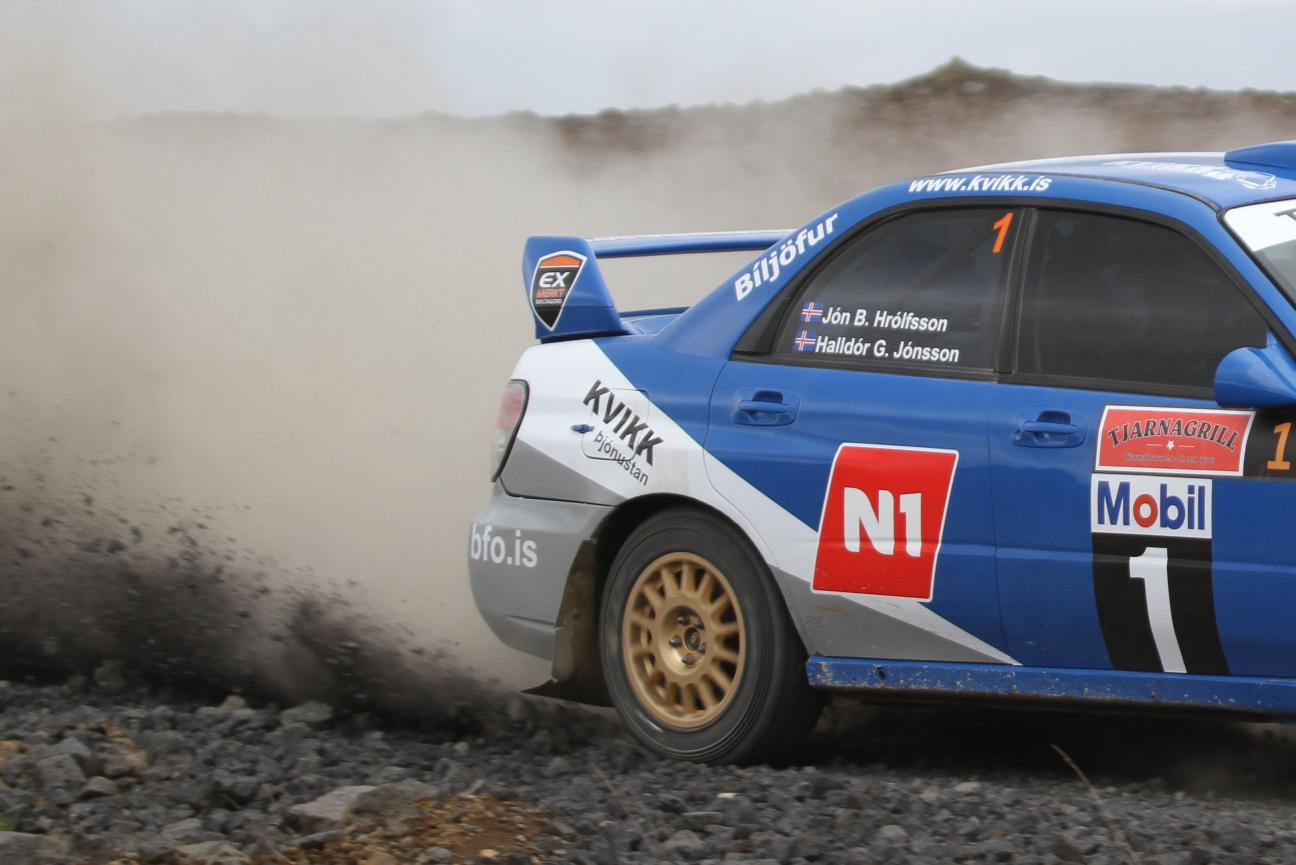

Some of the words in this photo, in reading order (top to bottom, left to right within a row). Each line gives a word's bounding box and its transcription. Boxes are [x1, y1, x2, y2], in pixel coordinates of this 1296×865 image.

[908, 175, 1053, 193] www.kvikk.is
[991, 211, 1015, 254] 1
[538, 271, 571, 288] EX
[821, 306, 851, 325] Jón
[853, 308, 869, 326] B.
[873, 309, 948, 332] Hrólfsson
[815, 335, 871, 356] Halldór
[873, 339, 889, 357] G.
[893, 341, 960, 363] Jónsson
[583, 379, 664, 467] KVIKK
[1107, 418, 1240, 451] TJARNAGRILL
[1266, 421, 1293, 470] 1
[843, 486, 922, 558] N1
[1096, 480, 1206, 531] Mobil
[471, 522, 538, 568] bfo.is
[1128, 546, 1188, 674] 1
